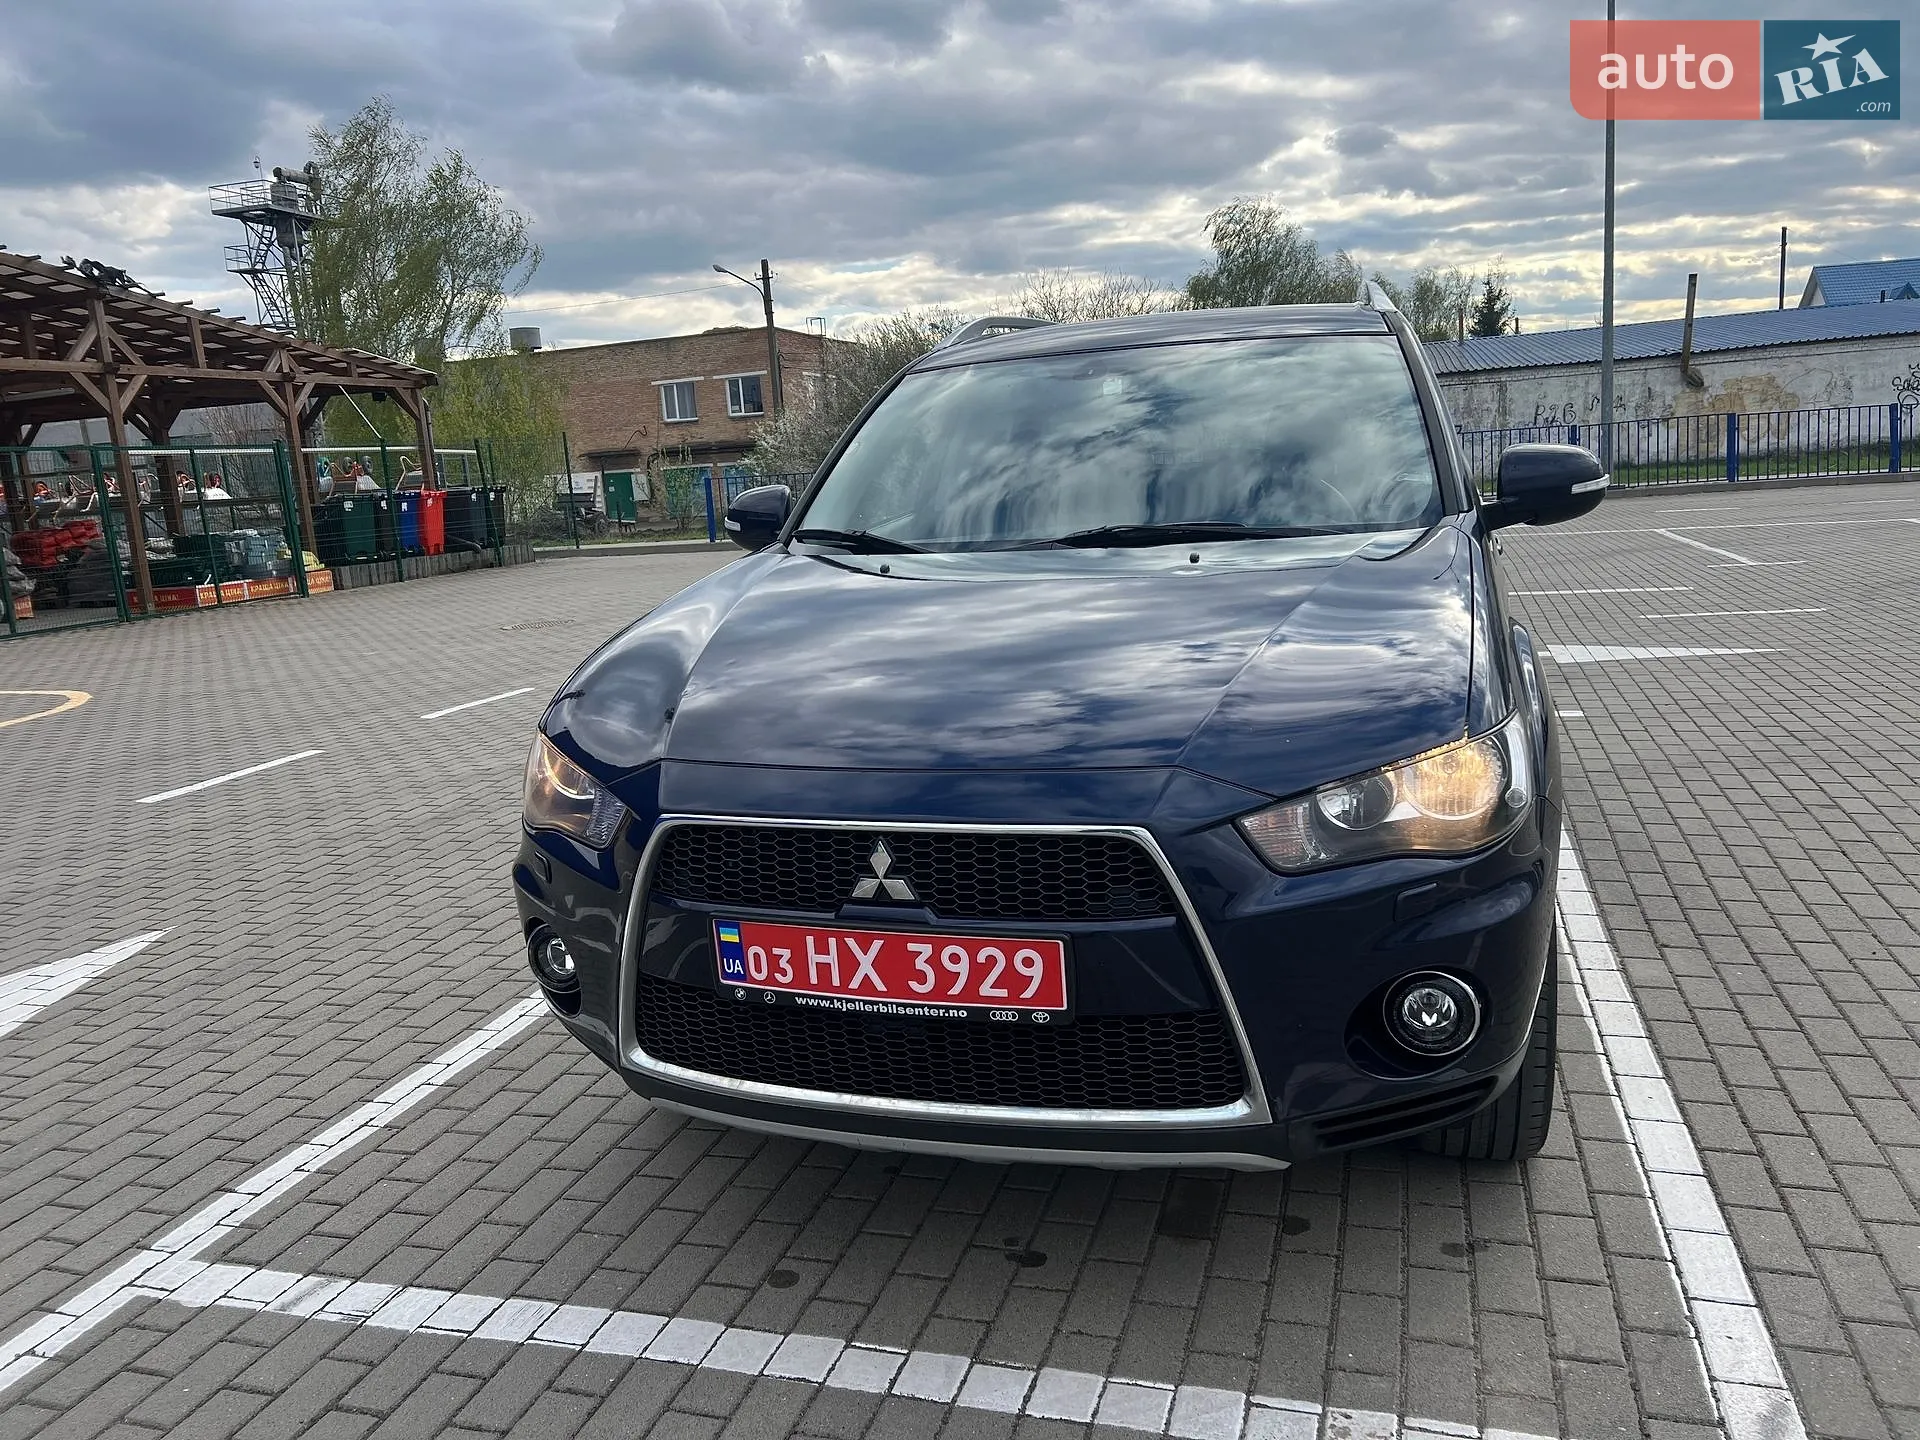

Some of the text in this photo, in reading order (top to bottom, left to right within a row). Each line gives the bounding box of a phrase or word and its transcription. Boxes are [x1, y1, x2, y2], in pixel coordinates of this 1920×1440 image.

[723, 935, 1044, 999] UA 03 HX 3929
[794, 995, 968, 1019] www.kjellerbilsenter.no
